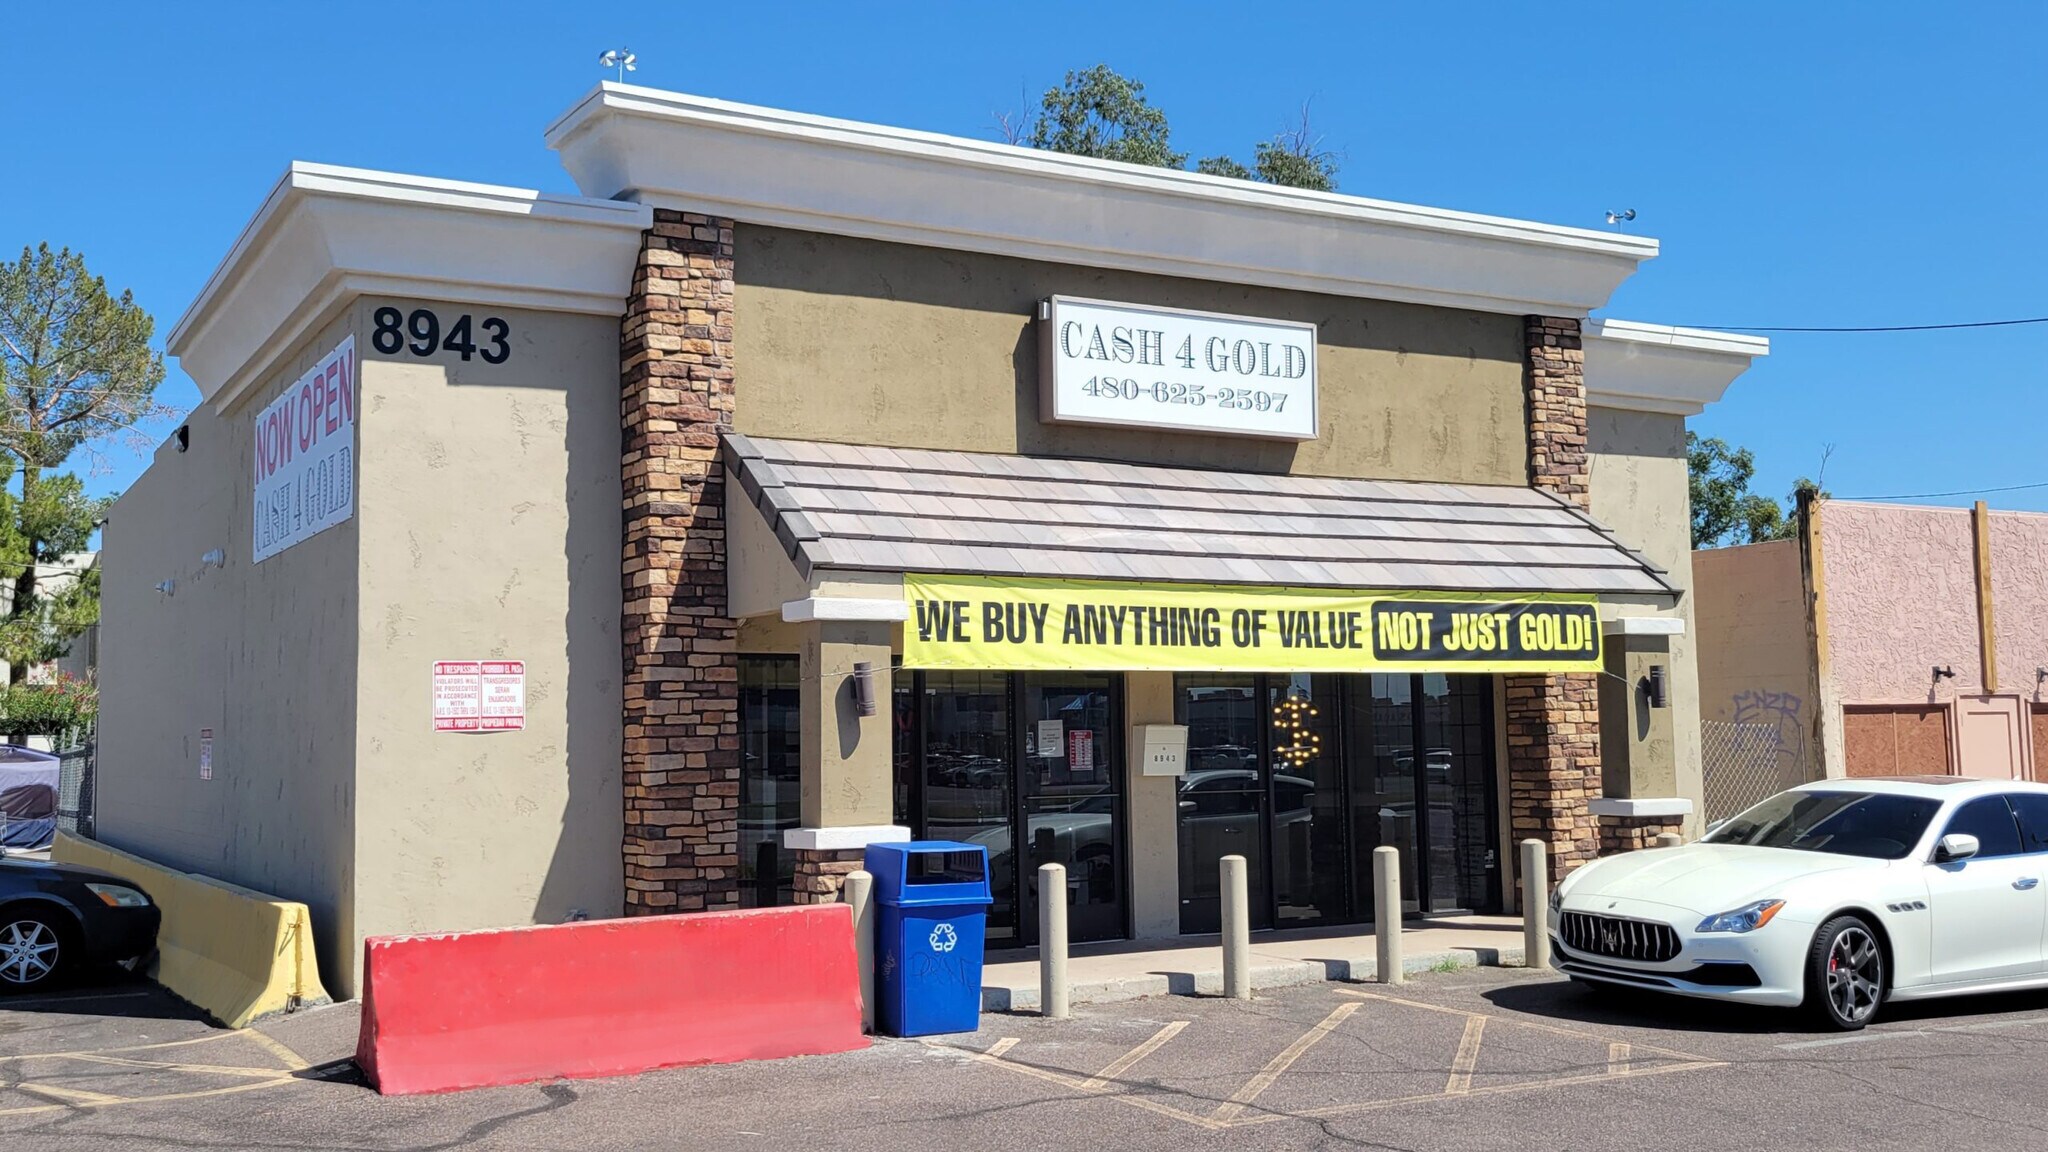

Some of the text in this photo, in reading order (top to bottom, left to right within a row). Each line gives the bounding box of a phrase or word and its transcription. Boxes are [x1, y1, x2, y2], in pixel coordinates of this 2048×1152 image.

[372, 306, 511, 364] 8943
[1060, 320, 1307, 380] CASH 4 GOLD
[255, 347, 354, 485] NOW OPEN
[1081, 375, 1289, 413] 480-625-2597
[254, 445, 352, 553] CASH 4 GOLD
[915, 599, 1594, 652] WE BUY ANYTHING OF VALUE NOT JUST GOLD!
[1154, 754, 1176, 762] 8943
